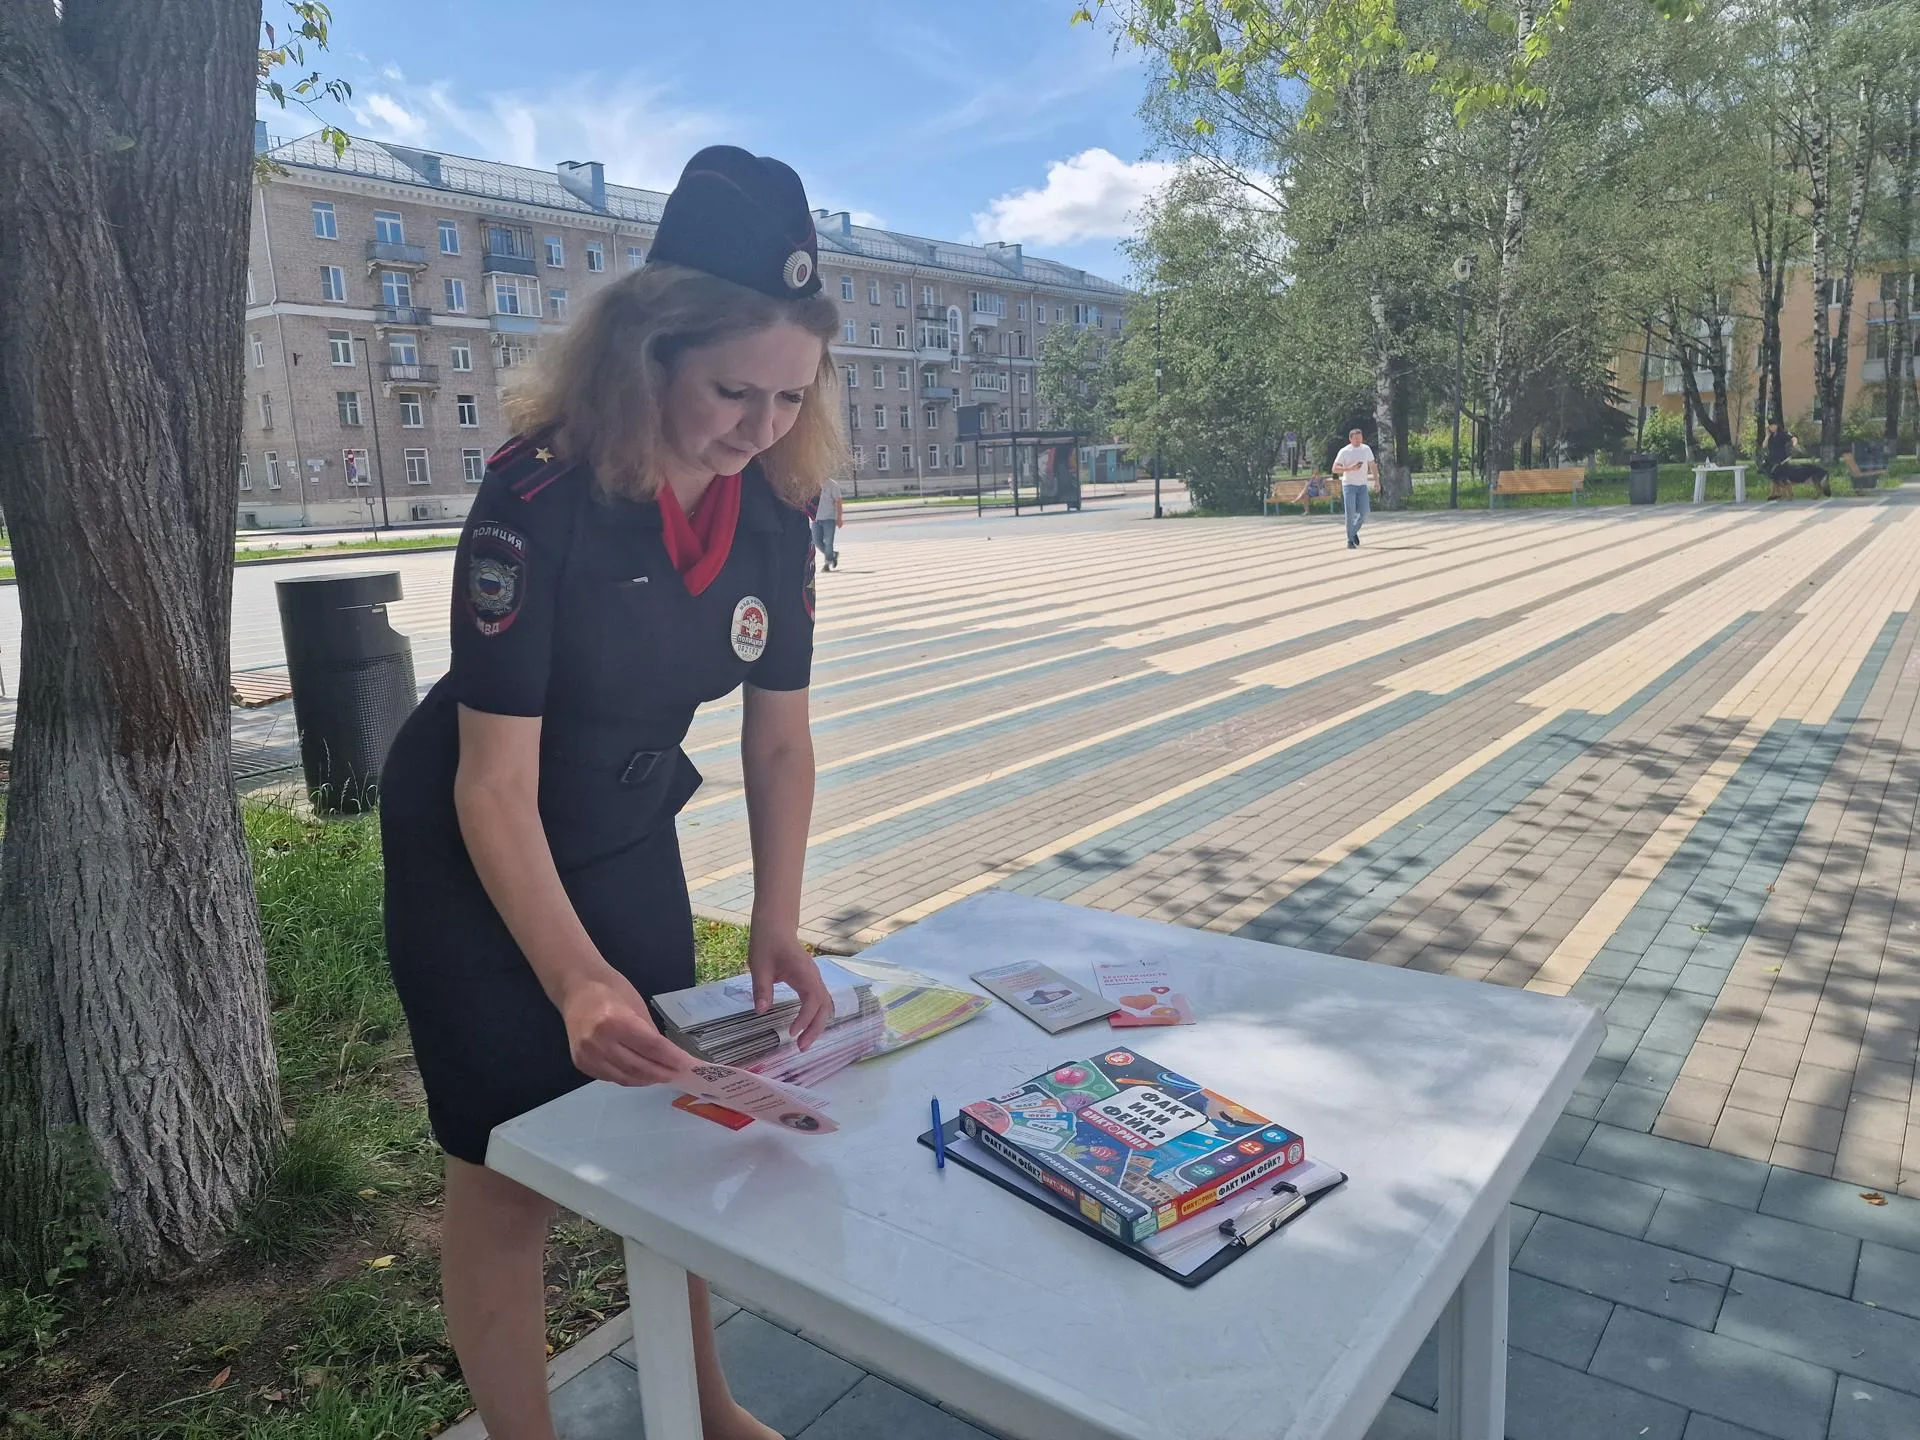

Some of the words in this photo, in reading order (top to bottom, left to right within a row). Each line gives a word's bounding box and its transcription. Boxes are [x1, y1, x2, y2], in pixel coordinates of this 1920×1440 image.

[473, 527, 522, 550] ПОЛИЦИЯ
[477, 617, 500, 635] МВД
[1128, 1102, 1171, 1125] ИЛИ
[1141, 1092, 1195, 1119] ФАКТ
[1032, 1123, 1054, 1131] ФАКТ
[1082, 1110, 1149, 1148] ВИКТОРИНА
[1103, 1106, 1165, 1140] ФЕЙК?
[984, 1134, 1002, 1151] ФАКТ
[1003, 1147, 1017, 1162] ИЛИ
[1018, 1158, 1041, 1178] ФЕЙК?
[1038, 1152, 1068, 1172] ИГРОВОЕ
[1067, 1168, 1088, 1185] ПОЛЕ
[1086, 1182, 1096, 1191] СО
[1095, 1188, 1133, 1215] СТРЕЛКОЙ
[1043, 1174, 1075, 1199] ВИКТОРИНА
[1218, 1177, 1240, 1196] ФАКТ
[1240, 1168, 1256, 1184] ИЛИ
[1257, 1155, 1282, 1174] ФЕЙК?
[1183, 1191, 1217, 1213] ВИКТОРИНА
